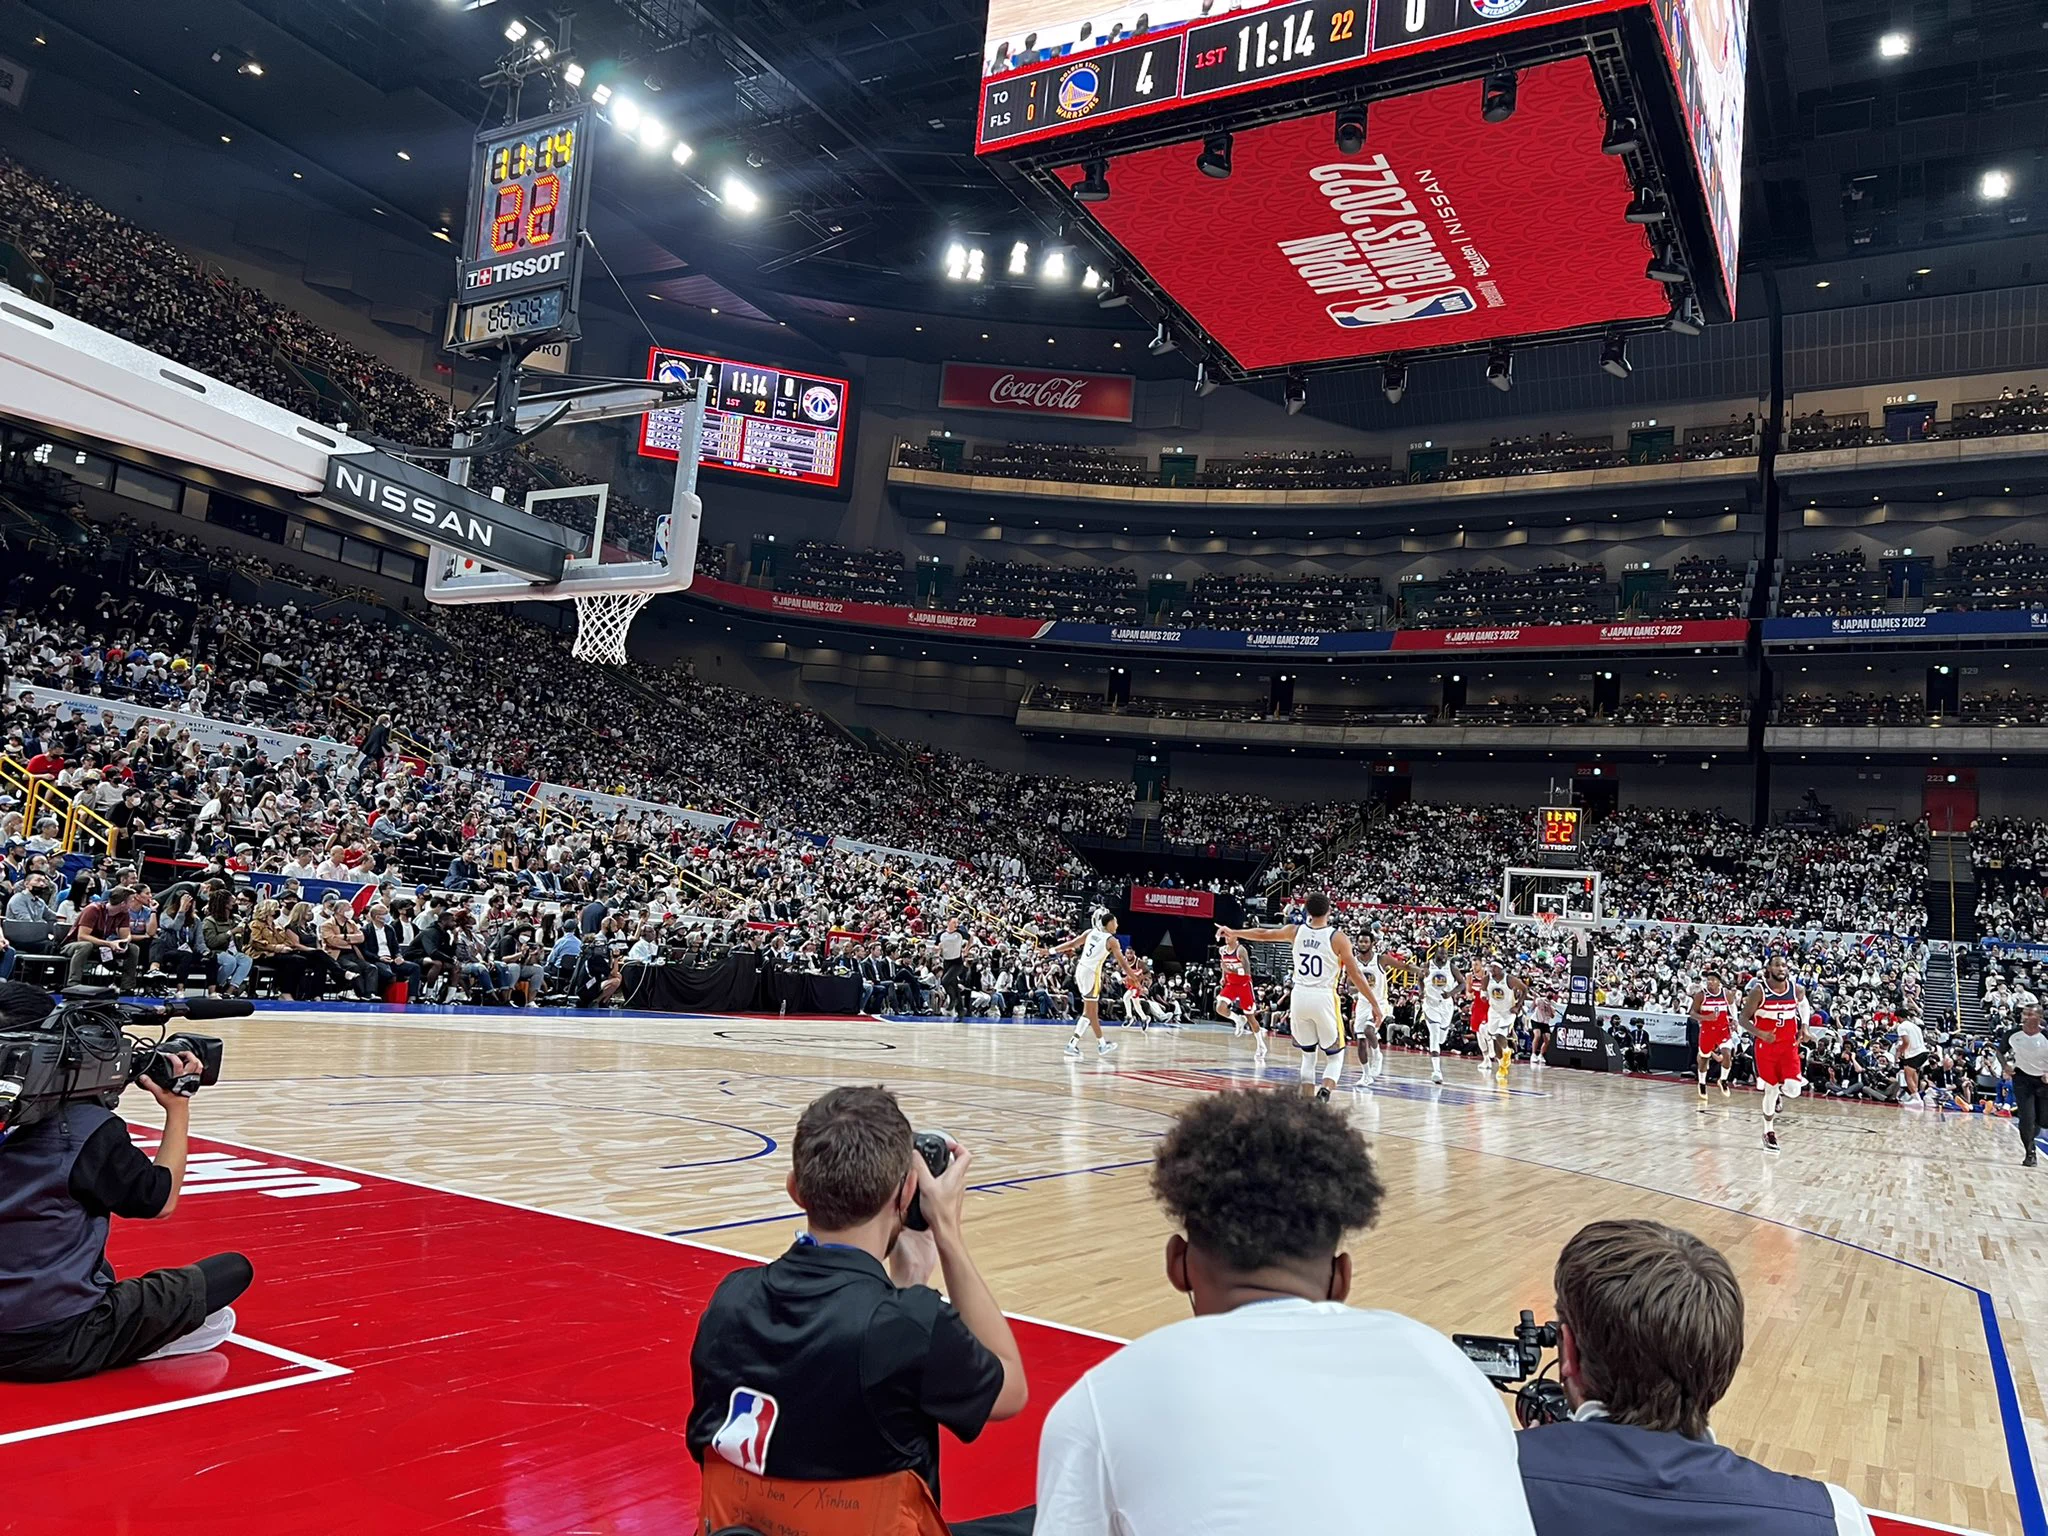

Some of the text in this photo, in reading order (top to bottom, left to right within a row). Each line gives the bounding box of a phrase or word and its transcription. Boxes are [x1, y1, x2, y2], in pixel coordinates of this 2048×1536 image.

[1194, 9, 1354, 72] 1ST 11:14 22
[1059, 62, 1100, 83] GOLDEN STATE
[1136, 51, 1153, 95] 4
[993, 80, 1037, 105] TO 7
[1055, 96, 1099, 119] WARRIORS
[990, 104, 1034, 128] FLS 0
[500, 130, 573, 180] 11:14
[1415, 169, 1465, 235] NISSAN
[1309, 153, 1457, 289] GAMES 2022
[493, 251, 565, 283] TISSOT
[1277, 231, 1384, 295] JAPAN
[1460, 245, 1491, 277] Rakuten
[704, 363, 713, 383] 4
[732, 371, 768, 397] 11:14
[784, 377, 795, 398] 0
[989, 373, 1089, 409] Coca-Cola
[726, 397, 766, 415] 1ST 22
[1886, 396, 1903, 404] 514
[1631, 421, 1645, 429] 511
[335, 465, 493, 548] NISSAN
[1883, 549, 1899, 557] 421
[779, 597, 800, 608] JAPAN
[801, 599, 824, 611] GAMES
[825, 601, 843, 613] 2022
[914, 613, 936, 624] JAPAN
[937, 615, 958, 626] GAMES
[958, 617, 977, 627] 2022
[1840, 617, 1926, 630] JAPAN GAMES 2022
[1117, 629, 1139, 639] JAPAN
[1139, 630, 1162, 640] GAMES
[1162, 631, 1181, 641] 2022
[1451, 630, 1520, 641] JAPAN GAMES 2022
[1607, 625, 1683, 637] JAPAN GAMES 2022
[1253, 634, 1320, 646] JAPAN GAMES 2022
[64, 700, 98, 710] AMERICAN
[186, 721, 213, 730] INSTYLE
[263, 738, 283, 747] NEC
[1927, 774, 1944, 782] 223
[1547, 822, 1572, 842] 22
[1150, 894, 1167, 904] JAPAN
[1167, 894, 1185, 906] GAMES
[1185, 896, 1199, 907] 2022
[1086, 943, 1095, 957] 3
[1298, 953, 1322, 977] 30
[1566, 1014, 1590, 1022] Rakuten
[1776, 1012, 1785, 1027] 5
[1567, 1028, 1584, 1038] JAPAN
[1566, 1036, 1598, 1049] GAMES 2022
[115, 1061, 121, 1071] 1
[815, 1487, 860, 1510] Xinhua
